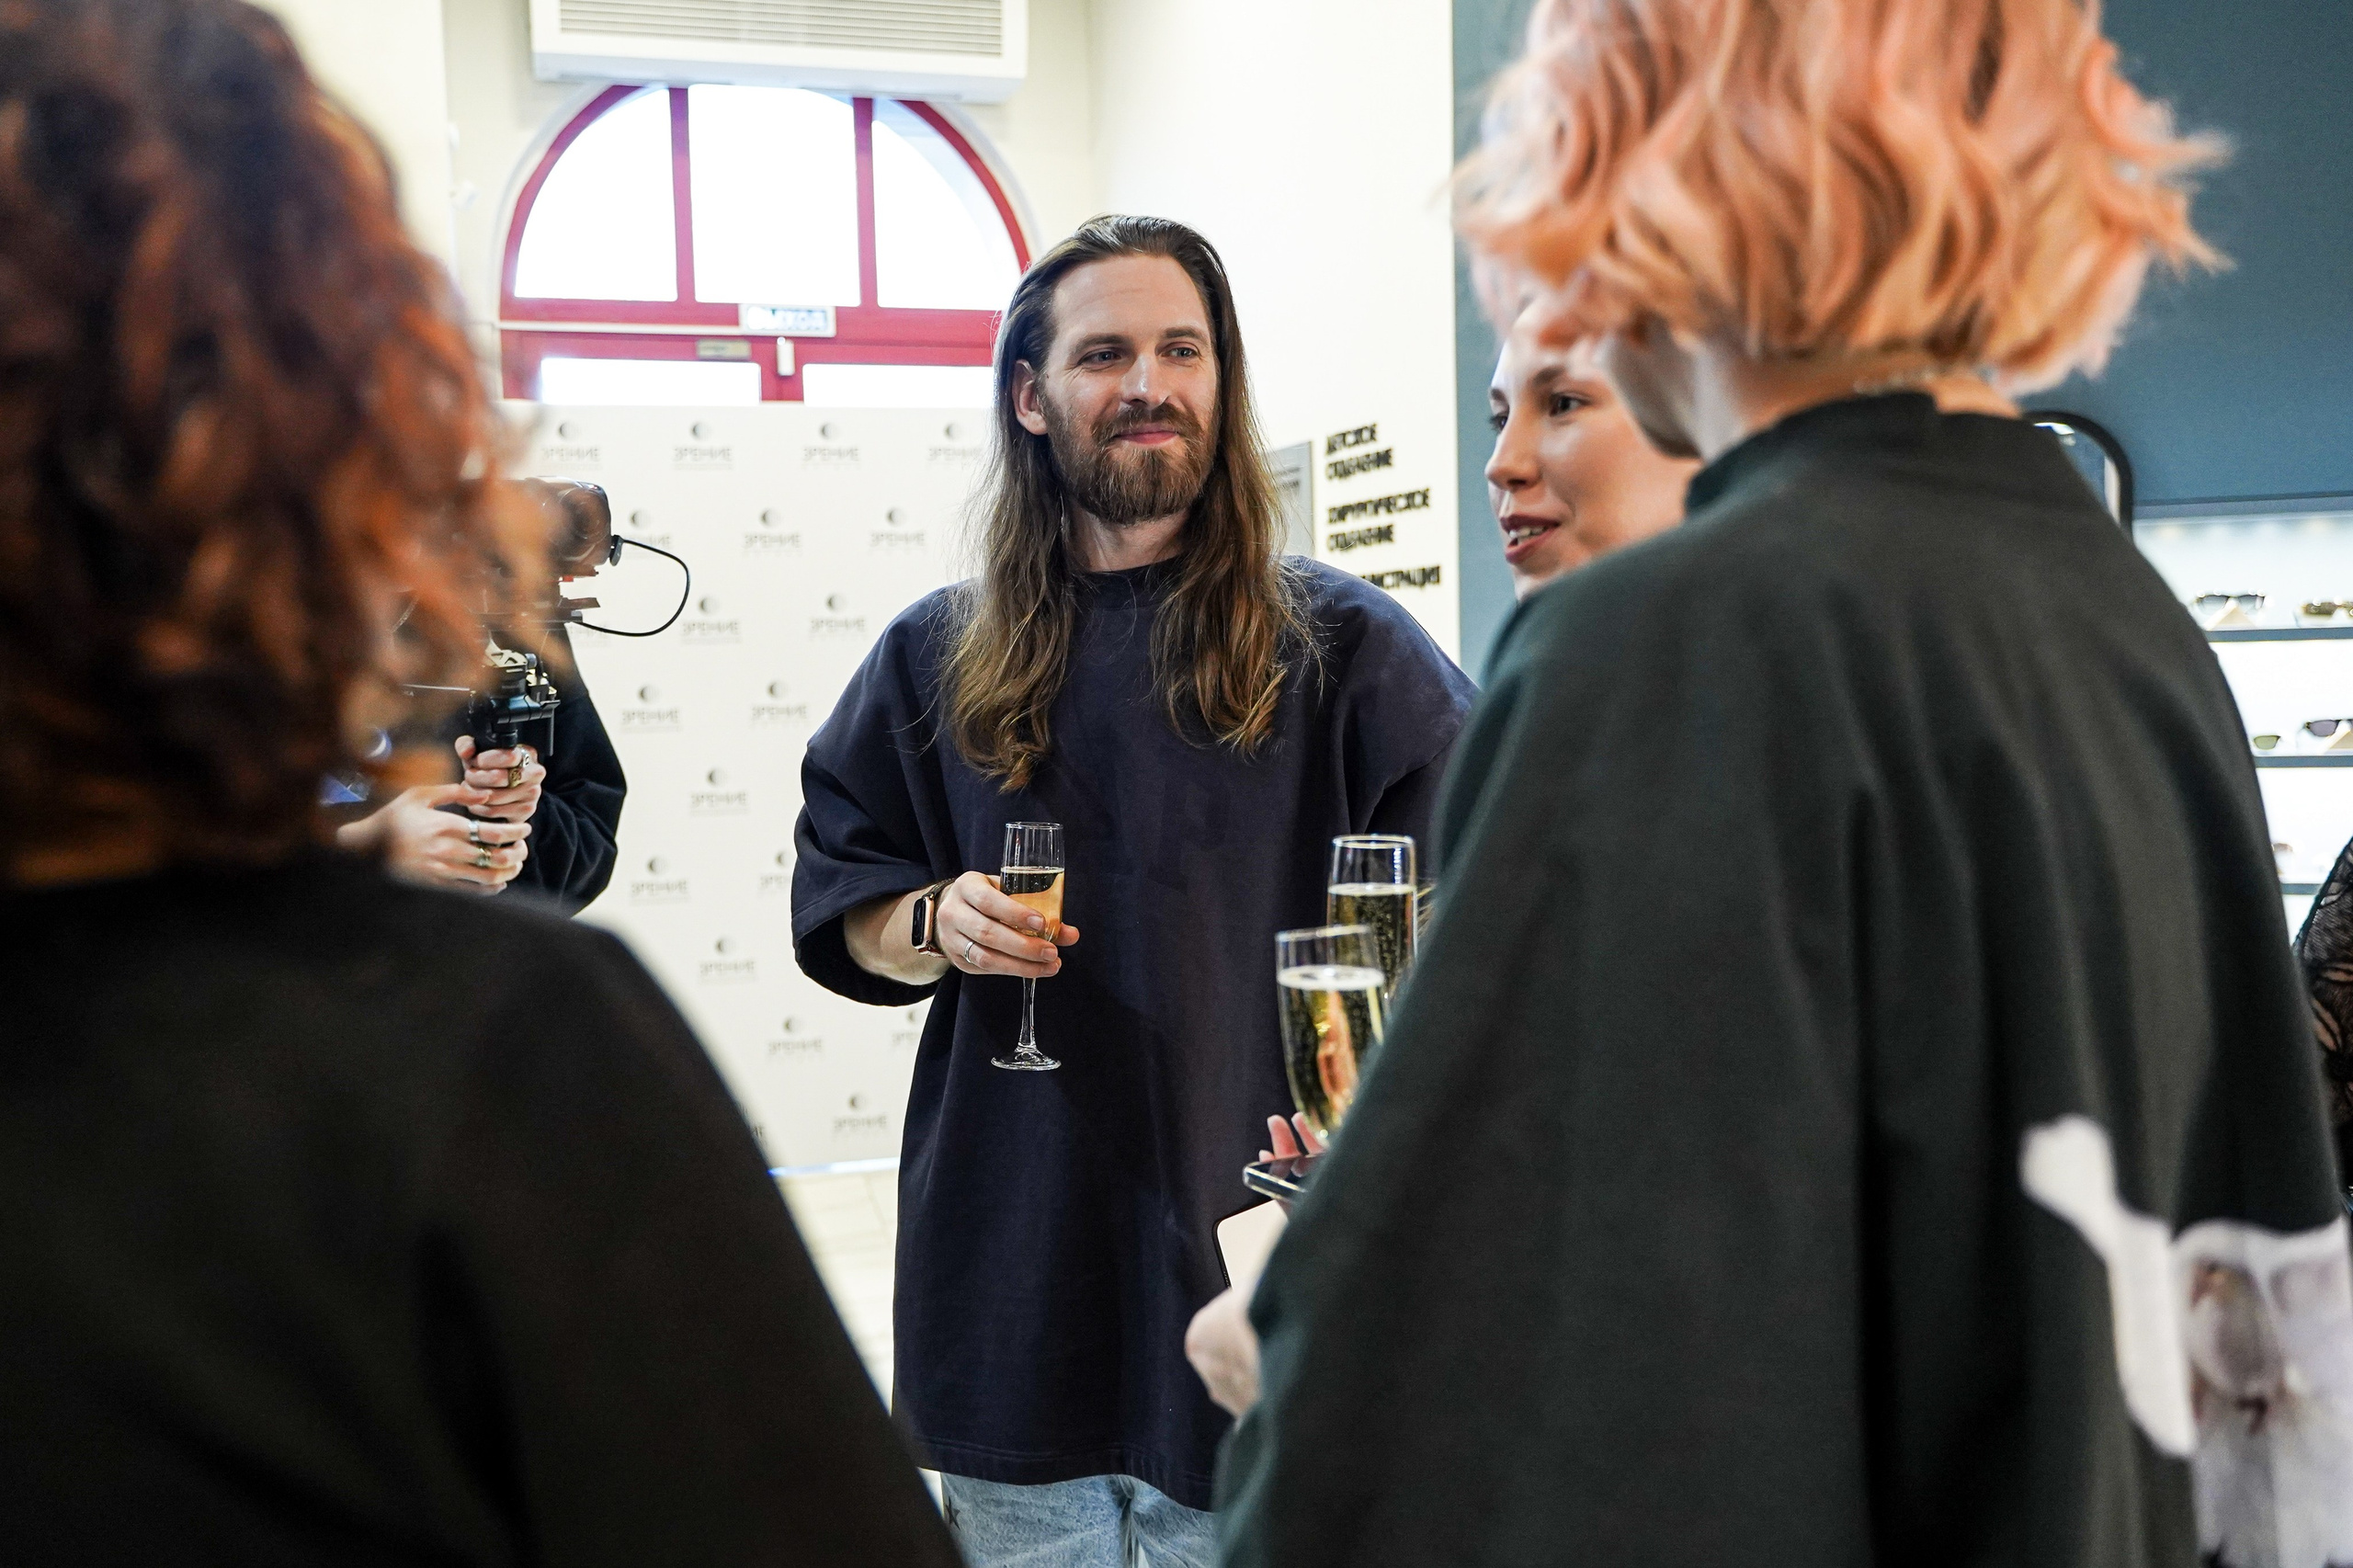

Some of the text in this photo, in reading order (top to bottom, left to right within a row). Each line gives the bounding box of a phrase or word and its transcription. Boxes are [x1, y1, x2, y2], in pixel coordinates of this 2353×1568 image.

[674, 446, 733, 461] ЗРЕНИЕ
[801, 446, 858, 460] ЗРЕНИЕ
[743, 533, 801, 549] ЗРЕНИЕ
[870, 531, 926, 547] ЗРЕНИЕ
[681, 619, 740, 635] ЗРЕНИЕ
[810, 617, 866, 631] ЗРЕНИЕ
[621, 707, 679, 724] ЗРЕНИЕ
[751, 705, 807, 722] ЗРЕНИЕ
[689, 791, 747, 808] ЗРЕНИЕ
[631, 879, 688, 898] ЗРЕНИЕ
